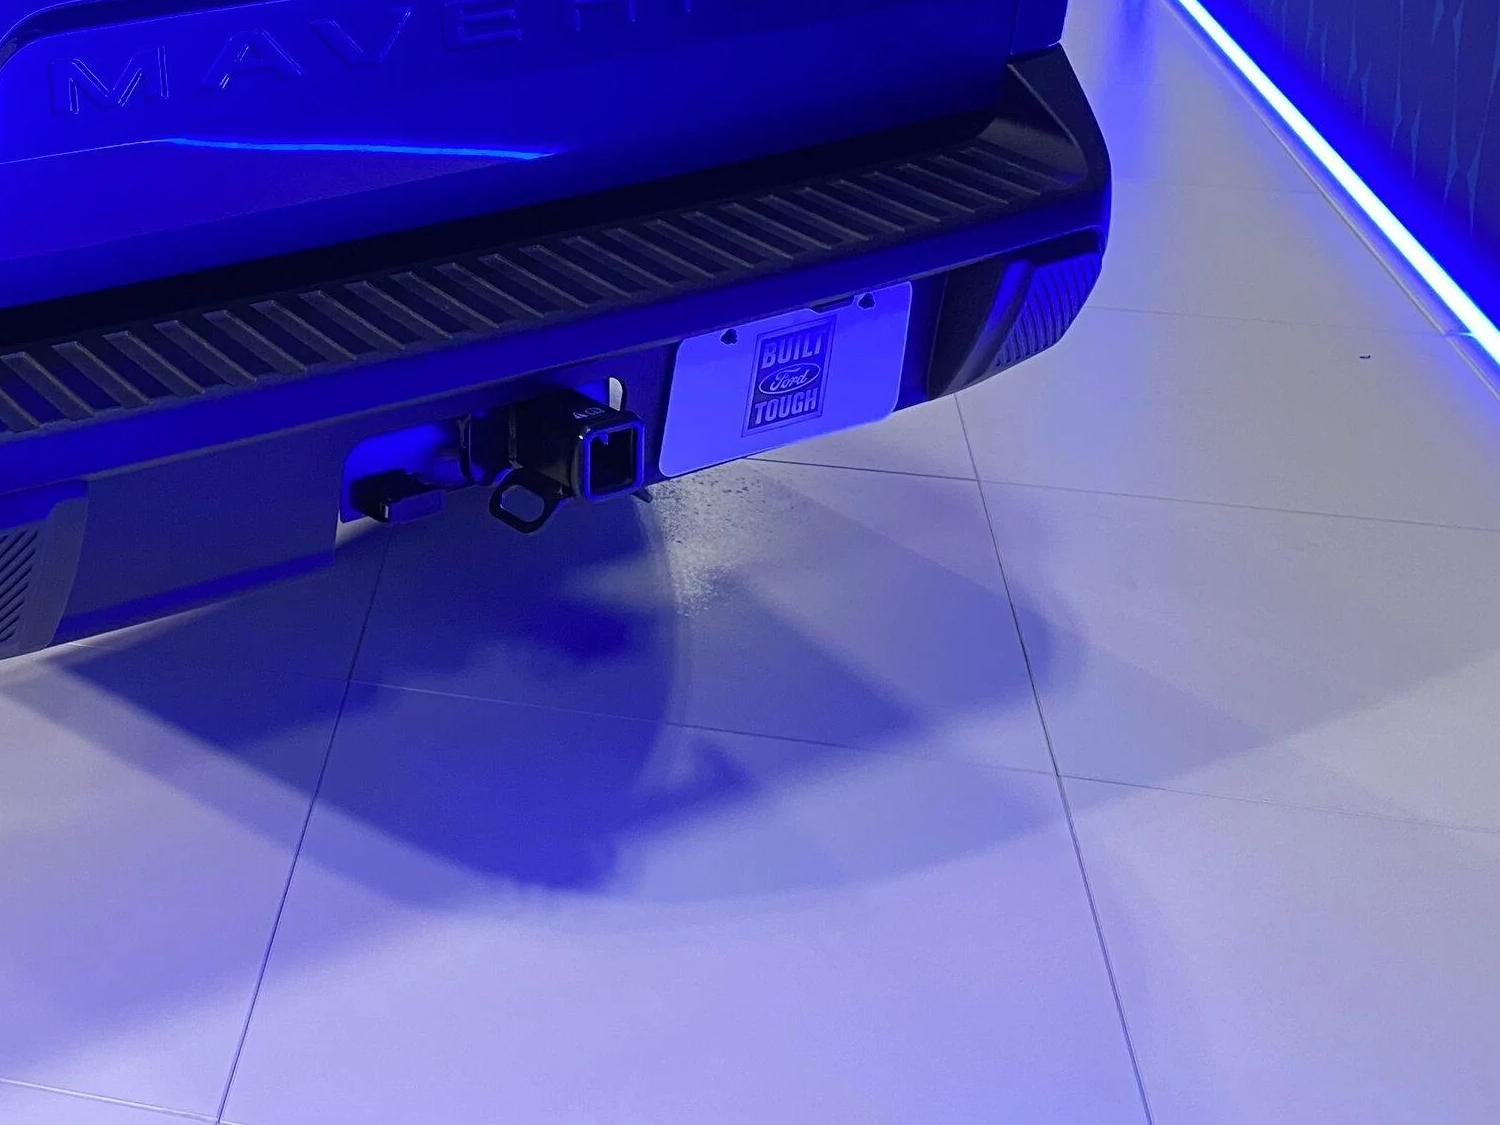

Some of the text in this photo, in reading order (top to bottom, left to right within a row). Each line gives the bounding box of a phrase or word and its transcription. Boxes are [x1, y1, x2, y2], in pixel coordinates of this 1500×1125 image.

[761, 328, 827, 370] BUILT
[769, 366, 811, 392] Ford
[754, 387, 819, 426] TOUGH
